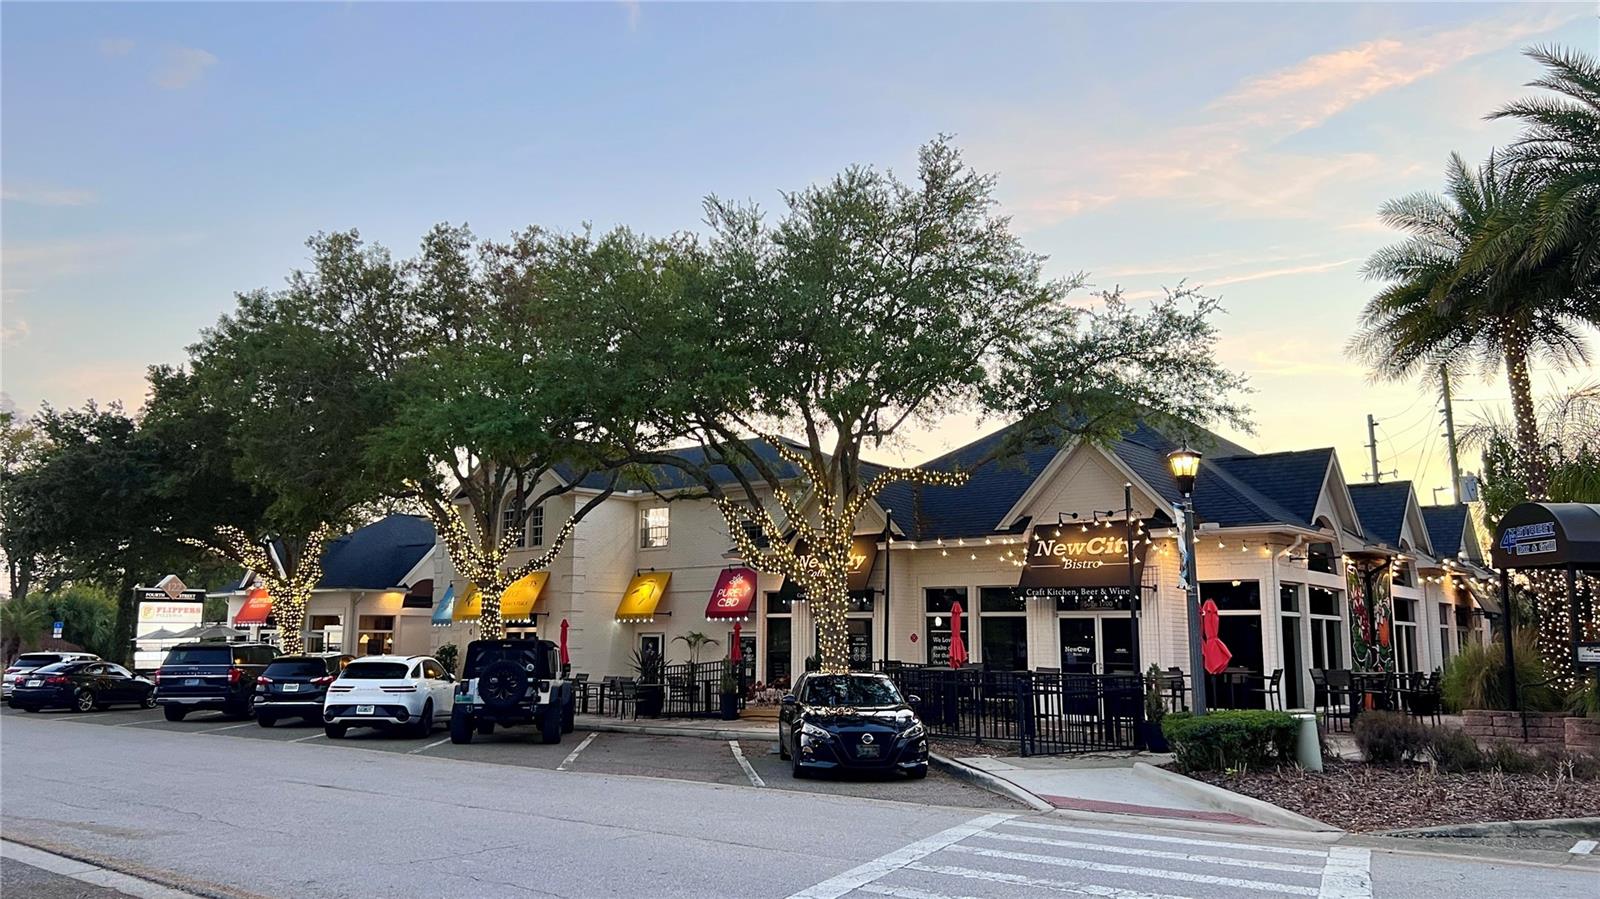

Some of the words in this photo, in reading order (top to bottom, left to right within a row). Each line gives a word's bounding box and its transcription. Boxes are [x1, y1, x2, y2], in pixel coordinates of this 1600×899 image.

[1034, 536, 1139, 558] NewCity
[1062, 558, 1101, 570] Bistro
[1026, 588, 1045, 597] Craft
[1047, 588, 1079, 598] Kitchen,
[1081, 588, 1098, 596] Beer
[1109, 587, 1130, 596] Wine
[717, 599, 740, 607] CBD
[156, 606, 201, 614] FLIPPERS
[1064, 646, 1090, 654] NewCity
